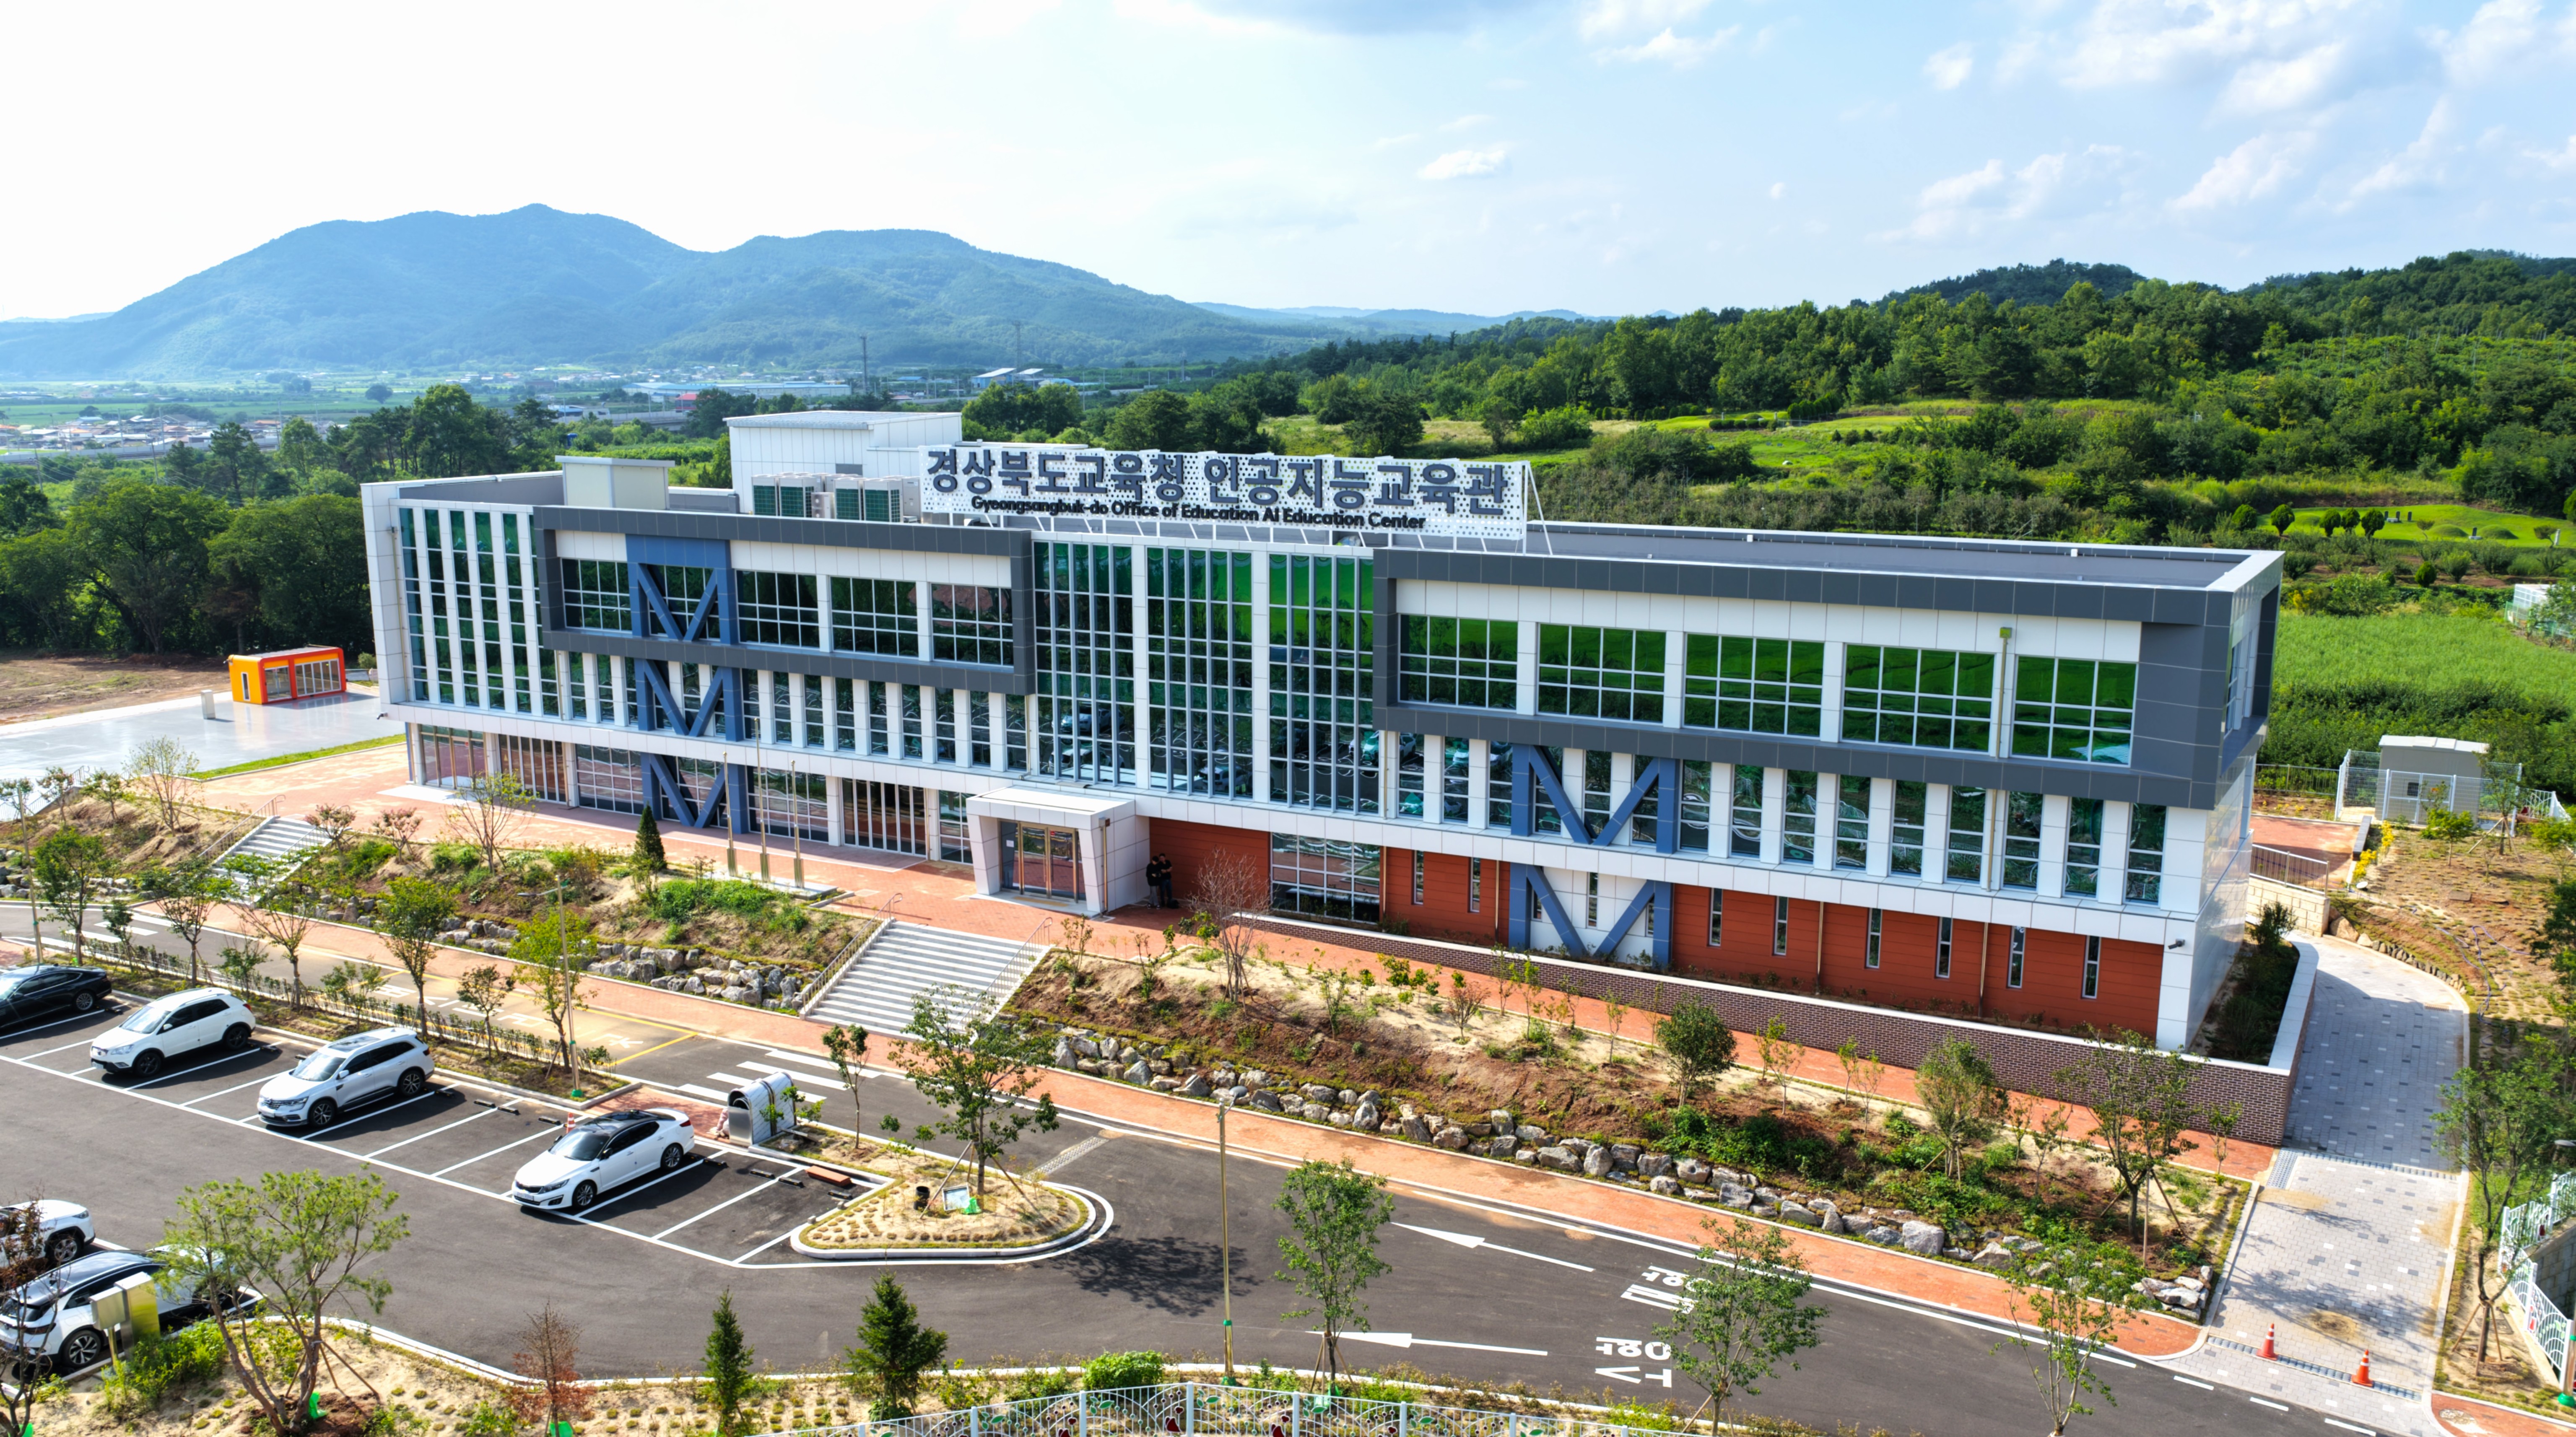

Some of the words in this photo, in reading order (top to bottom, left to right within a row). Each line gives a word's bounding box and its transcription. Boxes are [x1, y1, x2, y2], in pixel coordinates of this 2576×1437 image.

[927, 449, 1184, 502] 경상북도교육청
[1204, 457, 1508, 515] 인공지능교육관
[971, 495, 1109, 516] Gyeongsangbuk-do
[1111, 501, 1159, 517] Office
[1162, 503, 1179, 518] of
[1181, 505, 1259, 521] Education
[1262, 507, 1279, 522] AI
[1283, 508, 1364, 526] Education
[1368, 512, 1426, 529] Center
[1595, 1337, 1672, 1388] 소형
